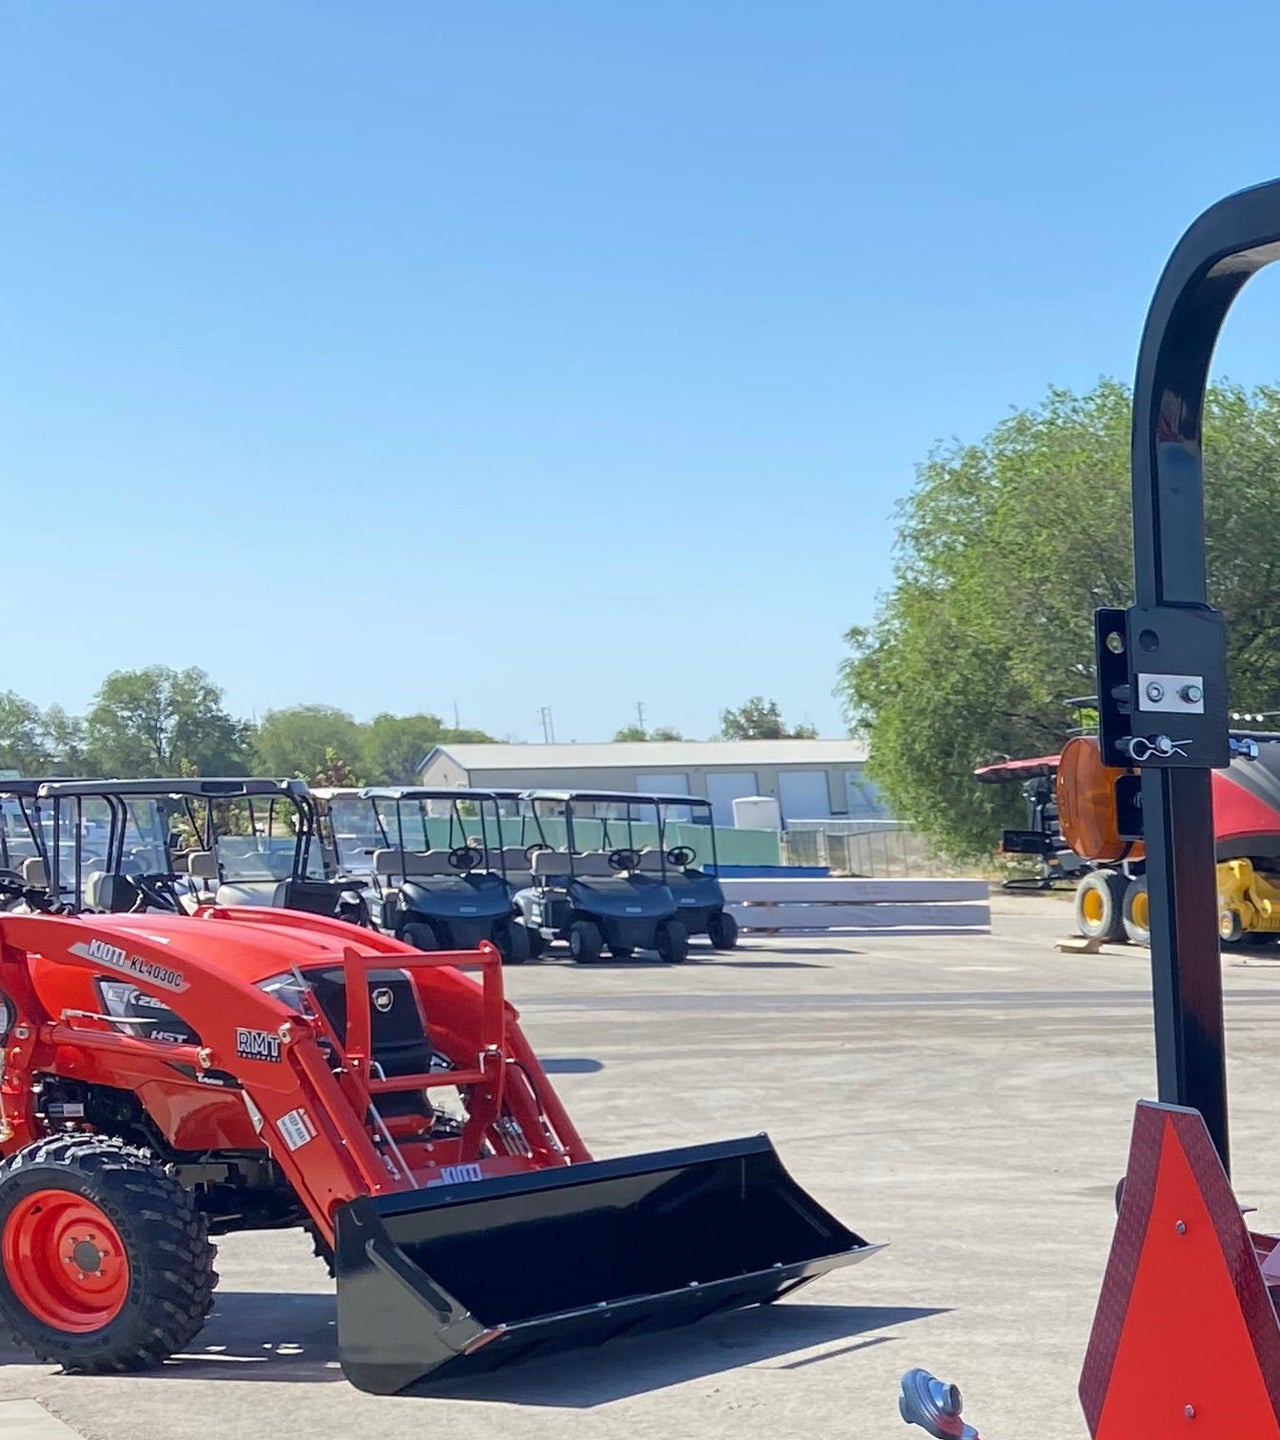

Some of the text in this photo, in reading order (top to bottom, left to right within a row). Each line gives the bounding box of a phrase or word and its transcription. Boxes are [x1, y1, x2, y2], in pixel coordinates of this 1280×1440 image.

[89, 939, 182, 987] KIOTI KL4030C
[150, 1030, 188, 1043] HST
[237, 1030, 280, 1056] RMT
